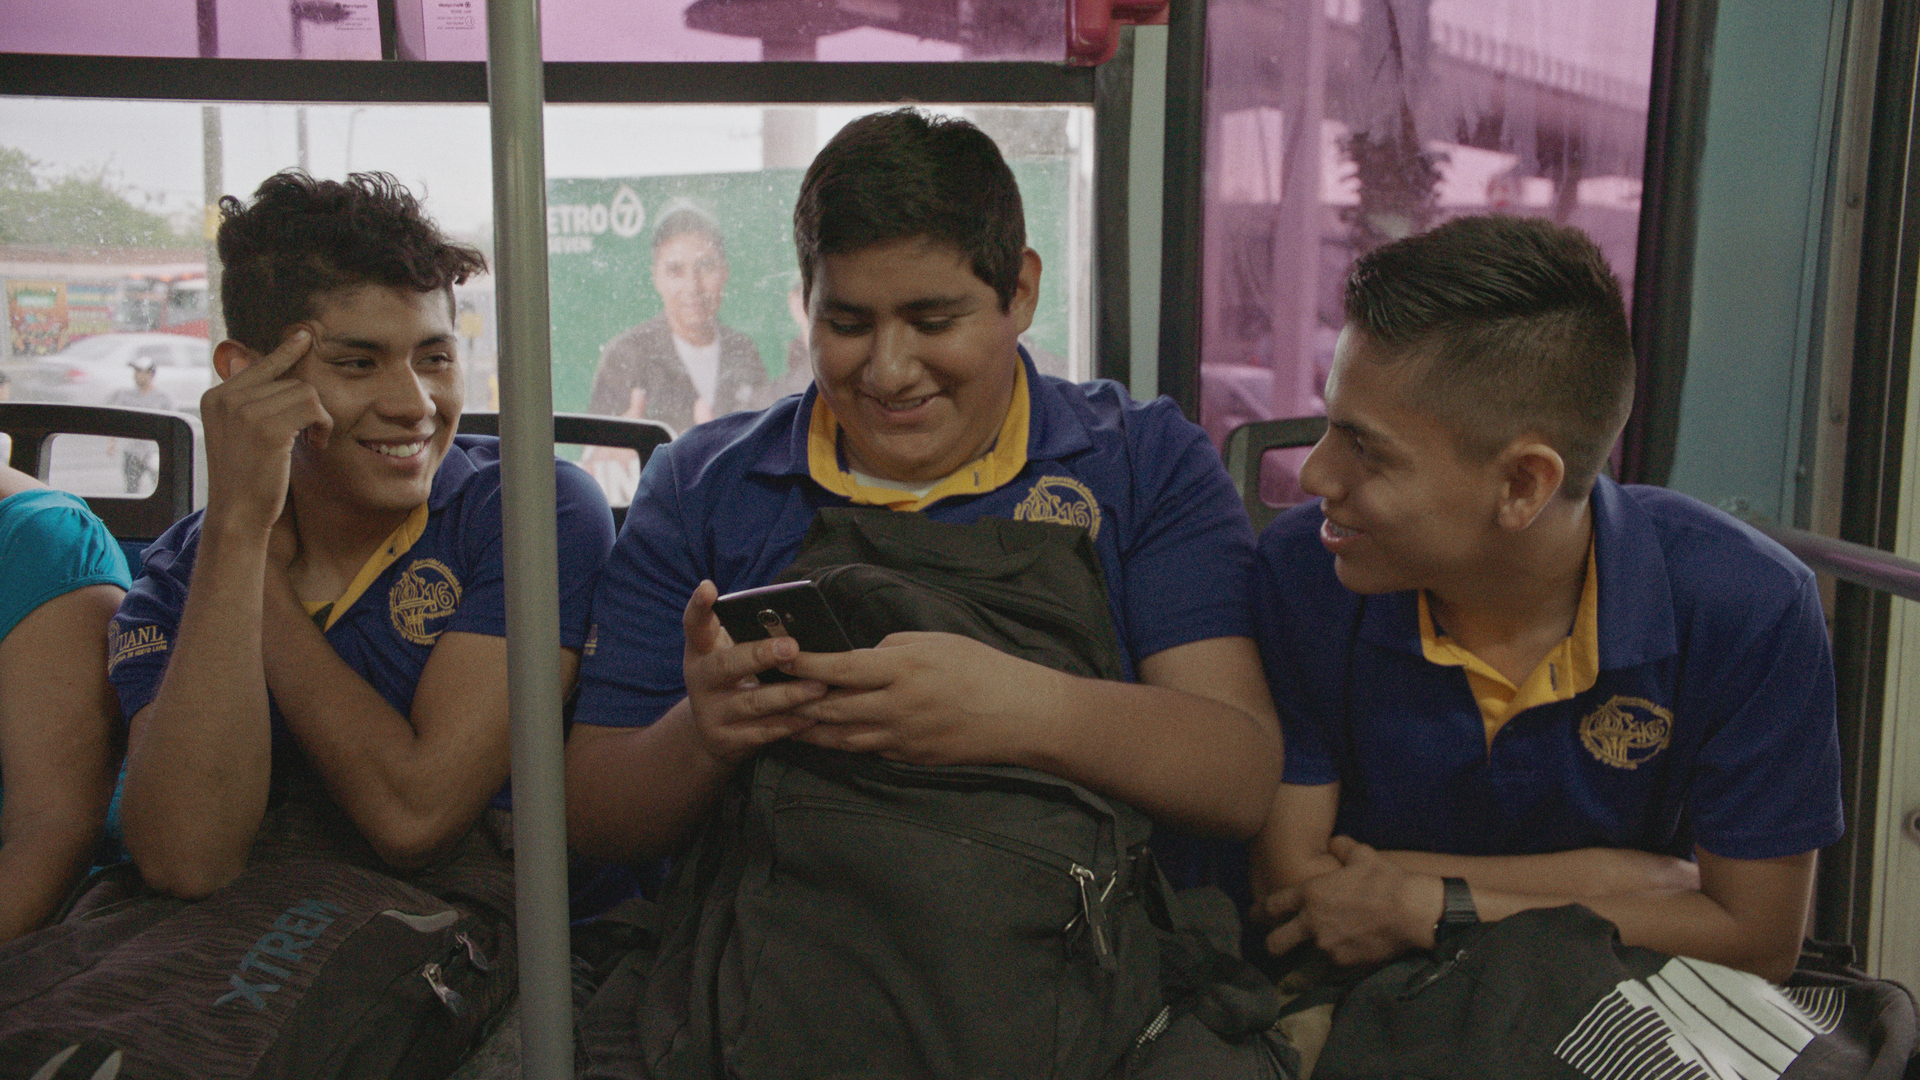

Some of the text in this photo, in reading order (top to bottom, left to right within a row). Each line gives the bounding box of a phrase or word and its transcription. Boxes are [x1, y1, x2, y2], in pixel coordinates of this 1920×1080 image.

[546, 204, 608, 234] ETRO
[425, 581, 455, 611] 16
[119, 625, 164, 651] UANL
